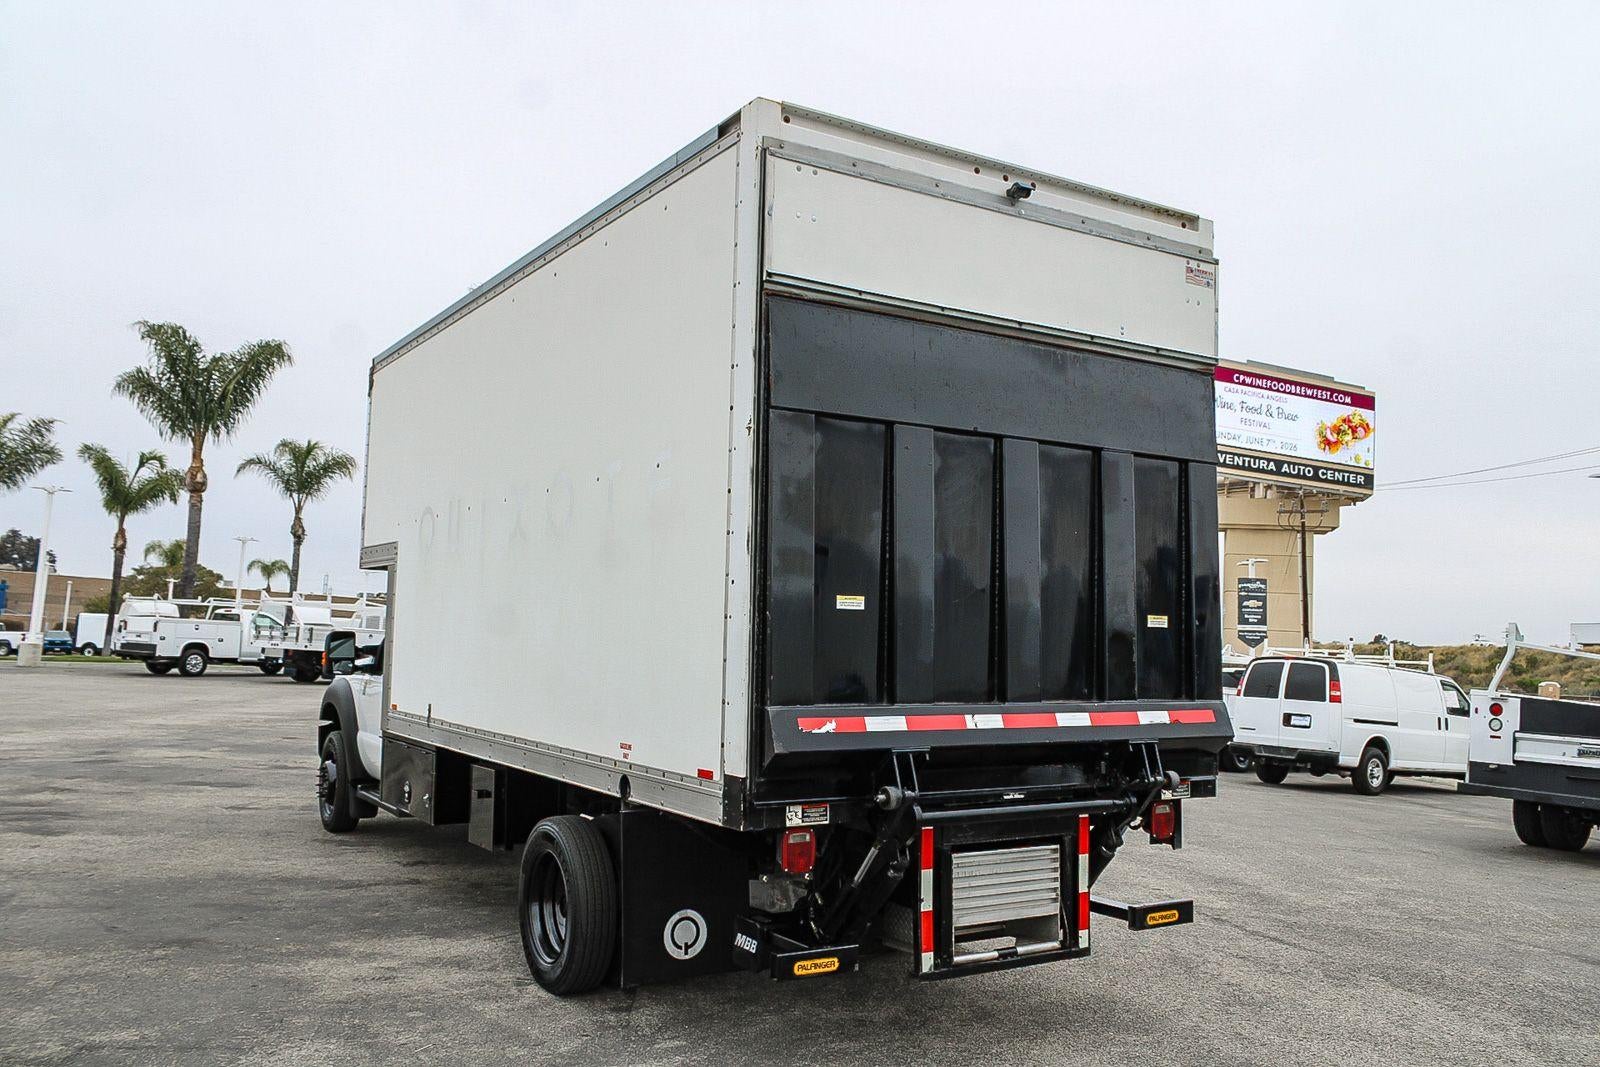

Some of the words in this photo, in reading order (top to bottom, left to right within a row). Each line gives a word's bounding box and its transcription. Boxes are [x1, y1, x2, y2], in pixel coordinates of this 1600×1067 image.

[1233, 374, 1351, 404] CPWINEFOODBREWFEST.COM
[1239, 401, 1264, 415] Food
[1265, 404, 1275, 418] &
[1276, 406, 1299, 421] Brew
[1240, 417, 1271, 430] FESTIVAL
[1245, 435, 1264, 446] JUNE
[1280, 441, 1298, 452] 2026
[1217, 453, 1276, 471] VENTURA
[1281, 463, 1313, 477] AUTO
[1318, 469, 1365, 484] CENTER
[734, 932, 759, 954] MBB
[796, 960, 837, 973] PALFINGER
